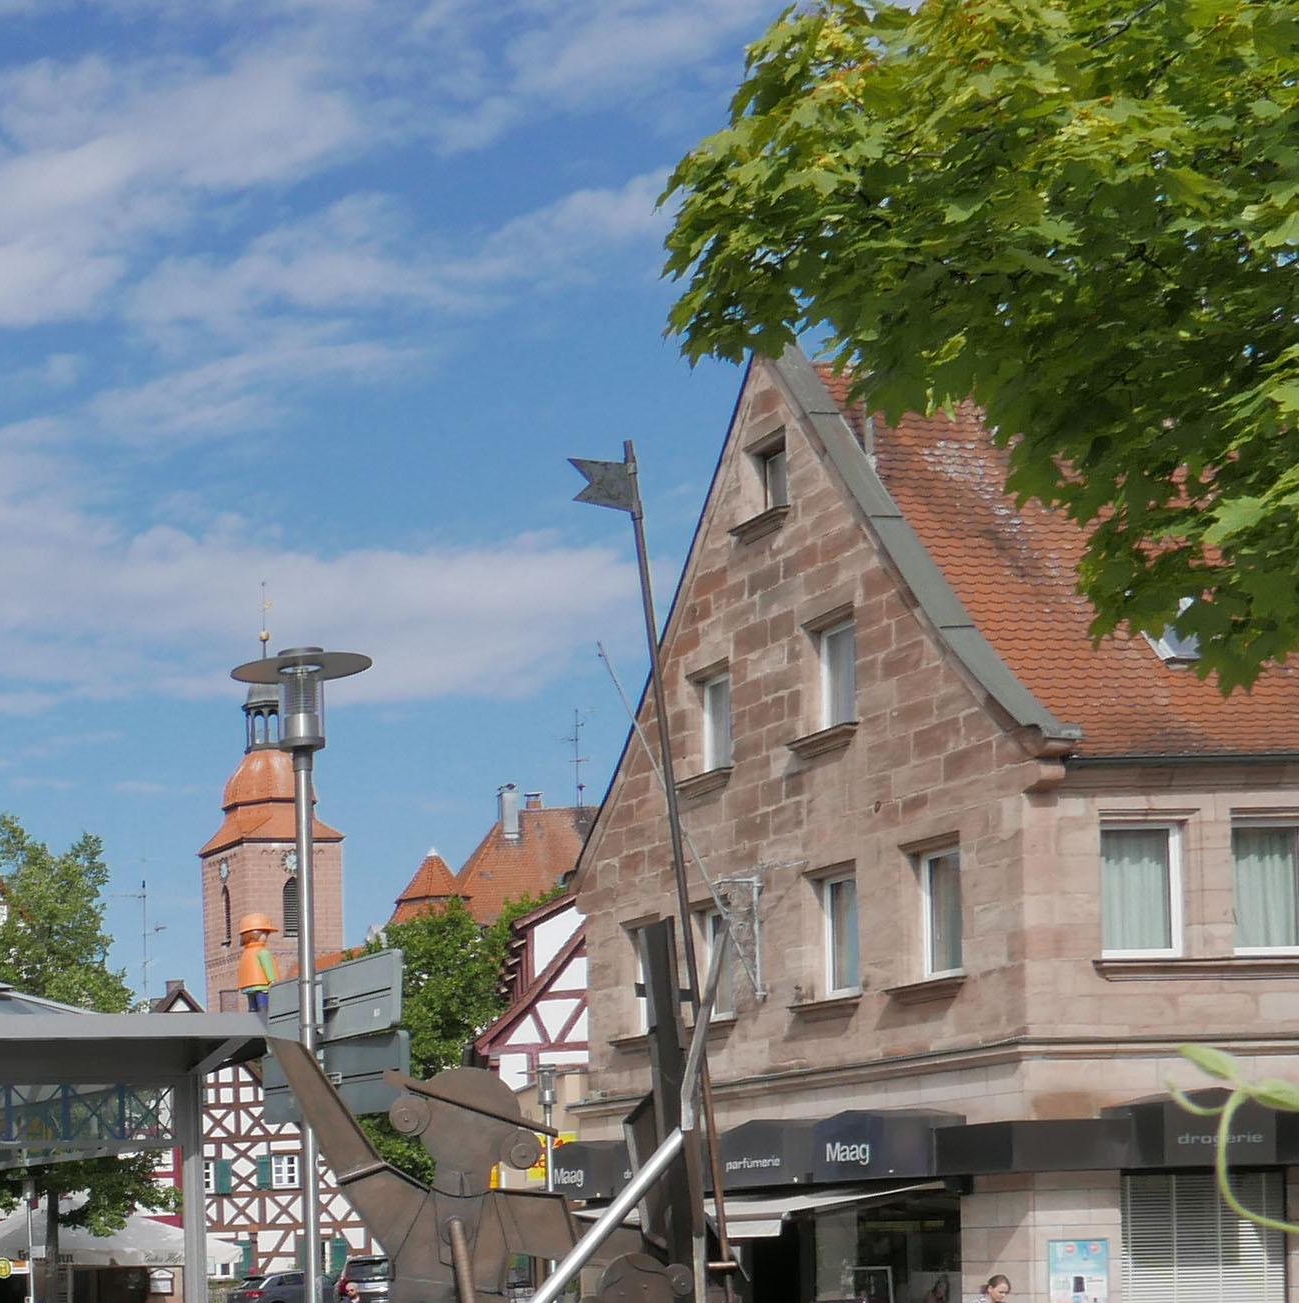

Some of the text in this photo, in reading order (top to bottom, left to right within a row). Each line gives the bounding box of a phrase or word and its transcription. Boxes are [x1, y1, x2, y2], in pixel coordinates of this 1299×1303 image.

[825, 1142, 870, 1166] Maag
[726, 1156, 781, 1172] parfümerie
[554, 1168, 584, 1187] Maag
